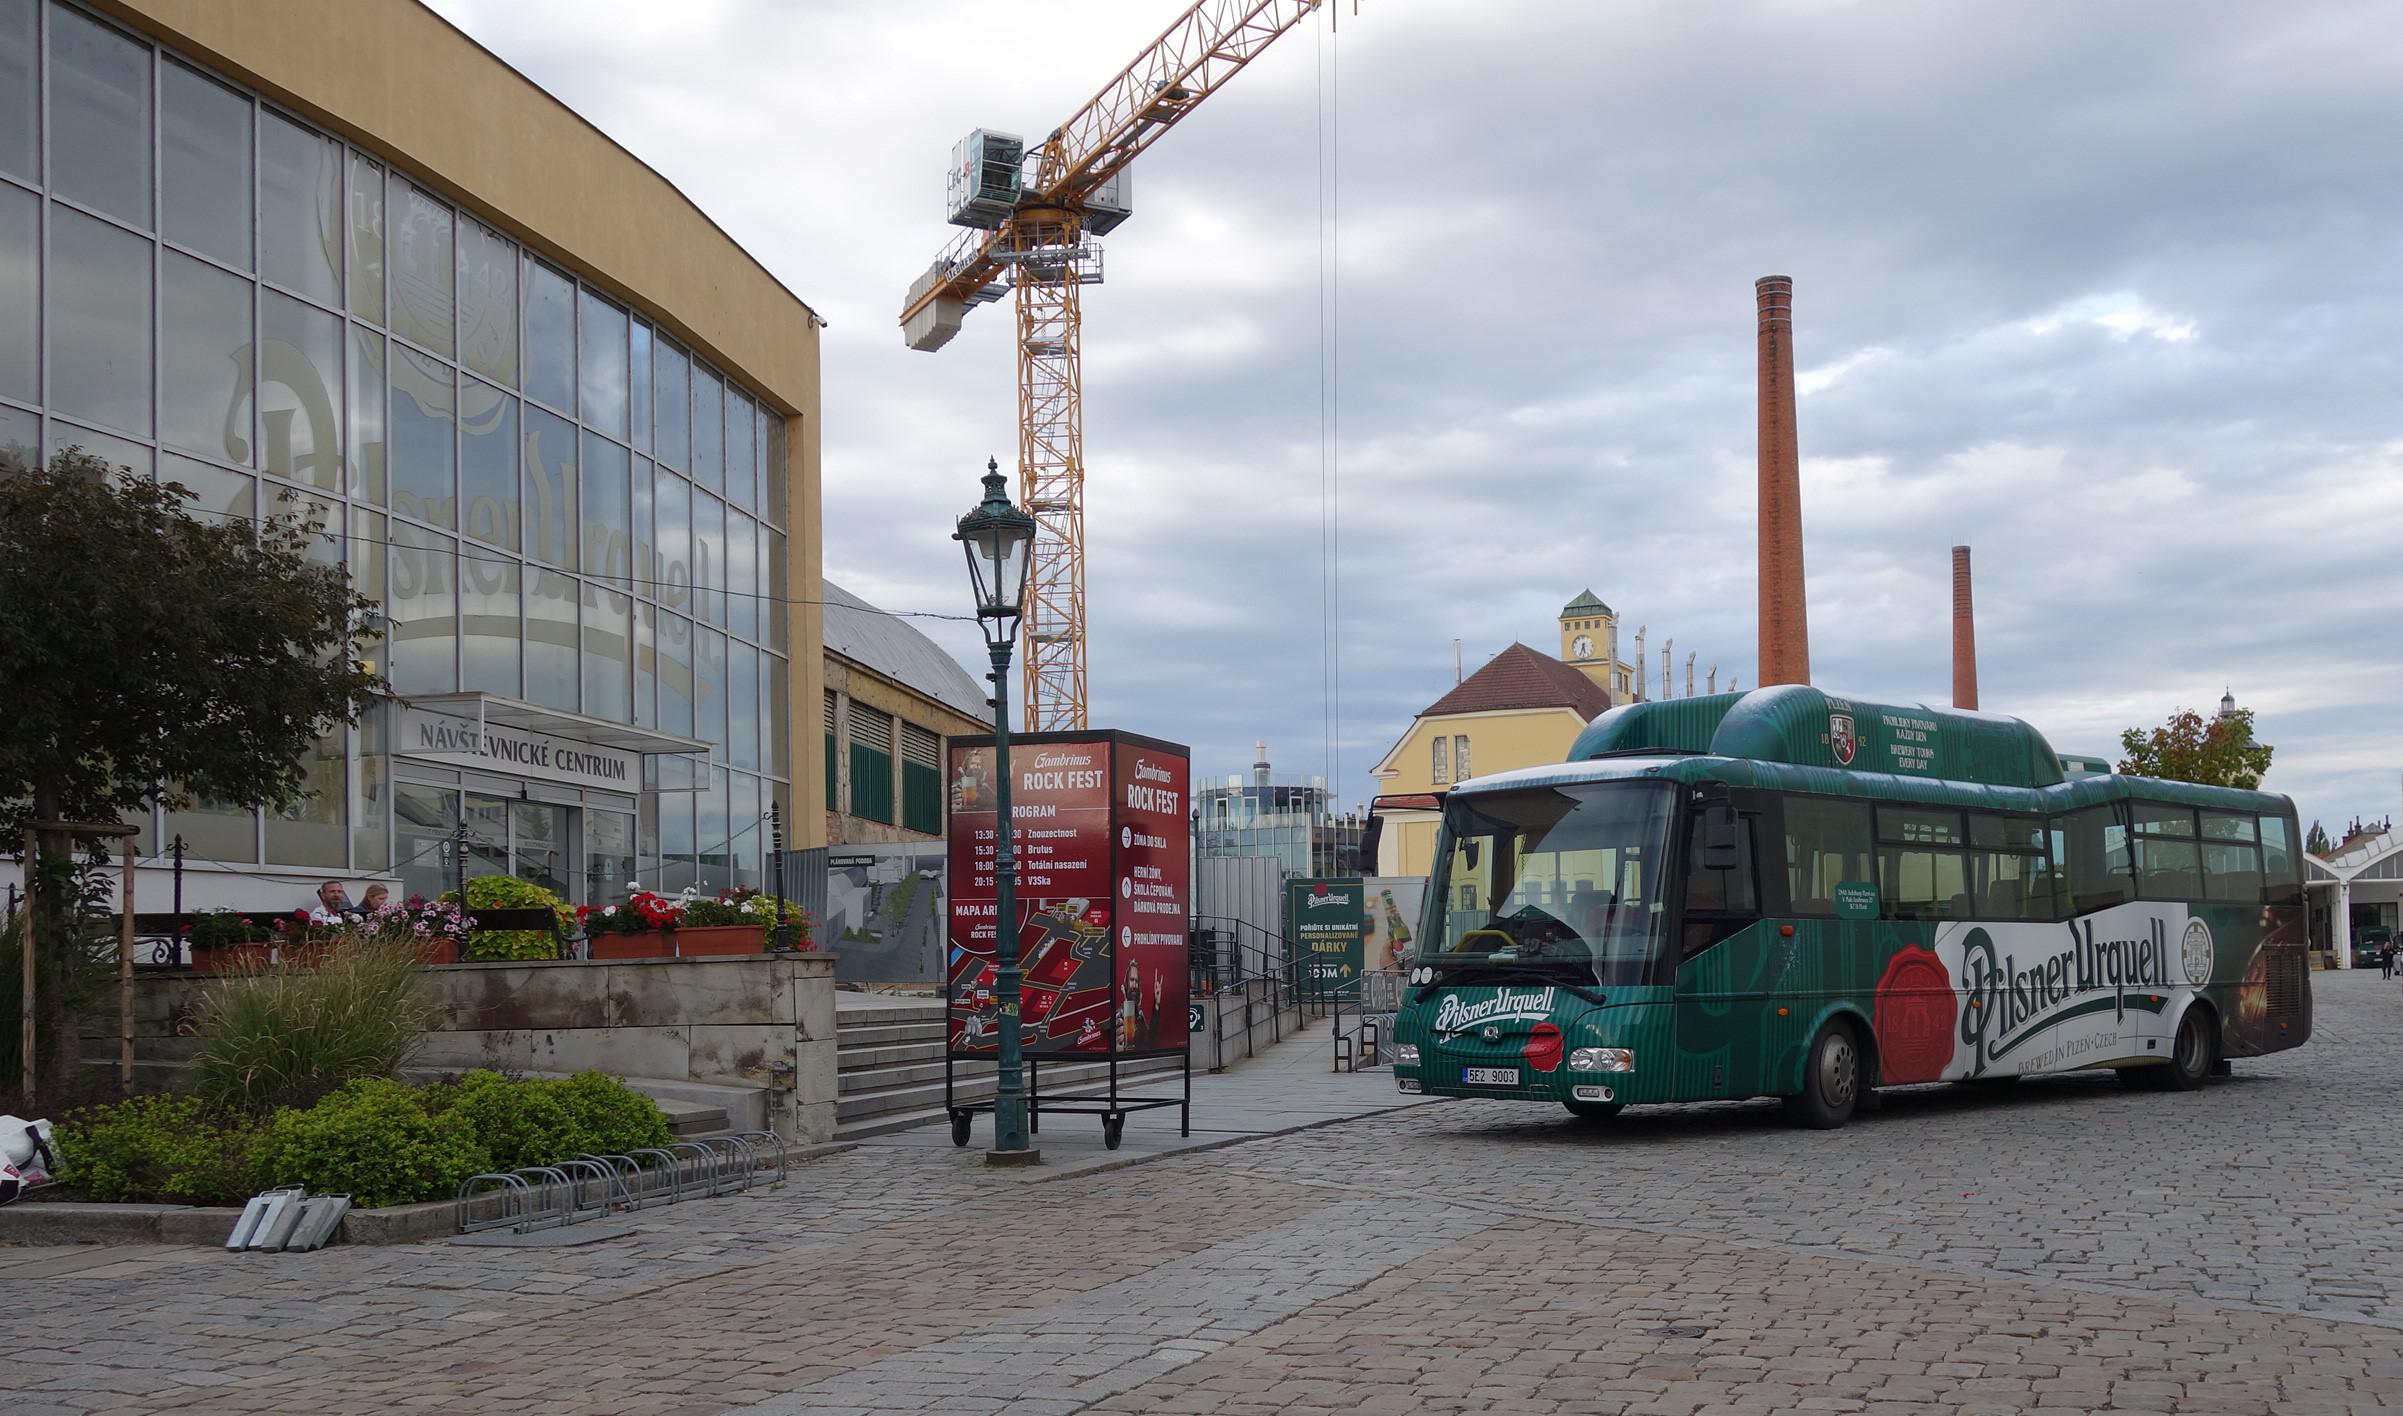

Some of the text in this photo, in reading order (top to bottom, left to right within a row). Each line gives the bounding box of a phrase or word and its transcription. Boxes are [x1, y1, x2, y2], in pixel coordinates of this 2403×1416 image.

[555, 748, 626, 781] CENTRUM
[1034, 751, 1093, 769] Gambrinus
[1899, 757, 1928, 770] EVERY DAY
[1134, 758, 1171, 784] Gambrinus
[1023, 769, 1104, 791] ROCK FEST
[1127, 783, 1178, 815] ROCK FEST
[1012, 804, 1056, 819] ROGRAM
[975, 830, 994, 840] 13:30
[1027, 828, 1077, 839] Znouzectnost
[975, 845, 994, 855] 15:30
[1027, 844, 1053, 854] Brutus
[975, 861, 994, 871] 18:00
[974, 877, 994, 886] 20:15
[1027, 876, 1051, 886] V3Ska
[955, 904, 980, 917] MAPA
[971, 931, 987, 939] ROCK
[1311, 940, 1347, 953] DÁRKY
[1962, 917, 2168, 1079] Pilsner Urquell
[1435, 986, 1553, 1045] Pilsner Urquell
[2017, 1050, 2055, 1075] BREWED
[2055, 1045, 2065, 1062] IN
[1470, 1069, 1486, 1082] 5E2
[1492, 1070, 1515, 1083] 9003
